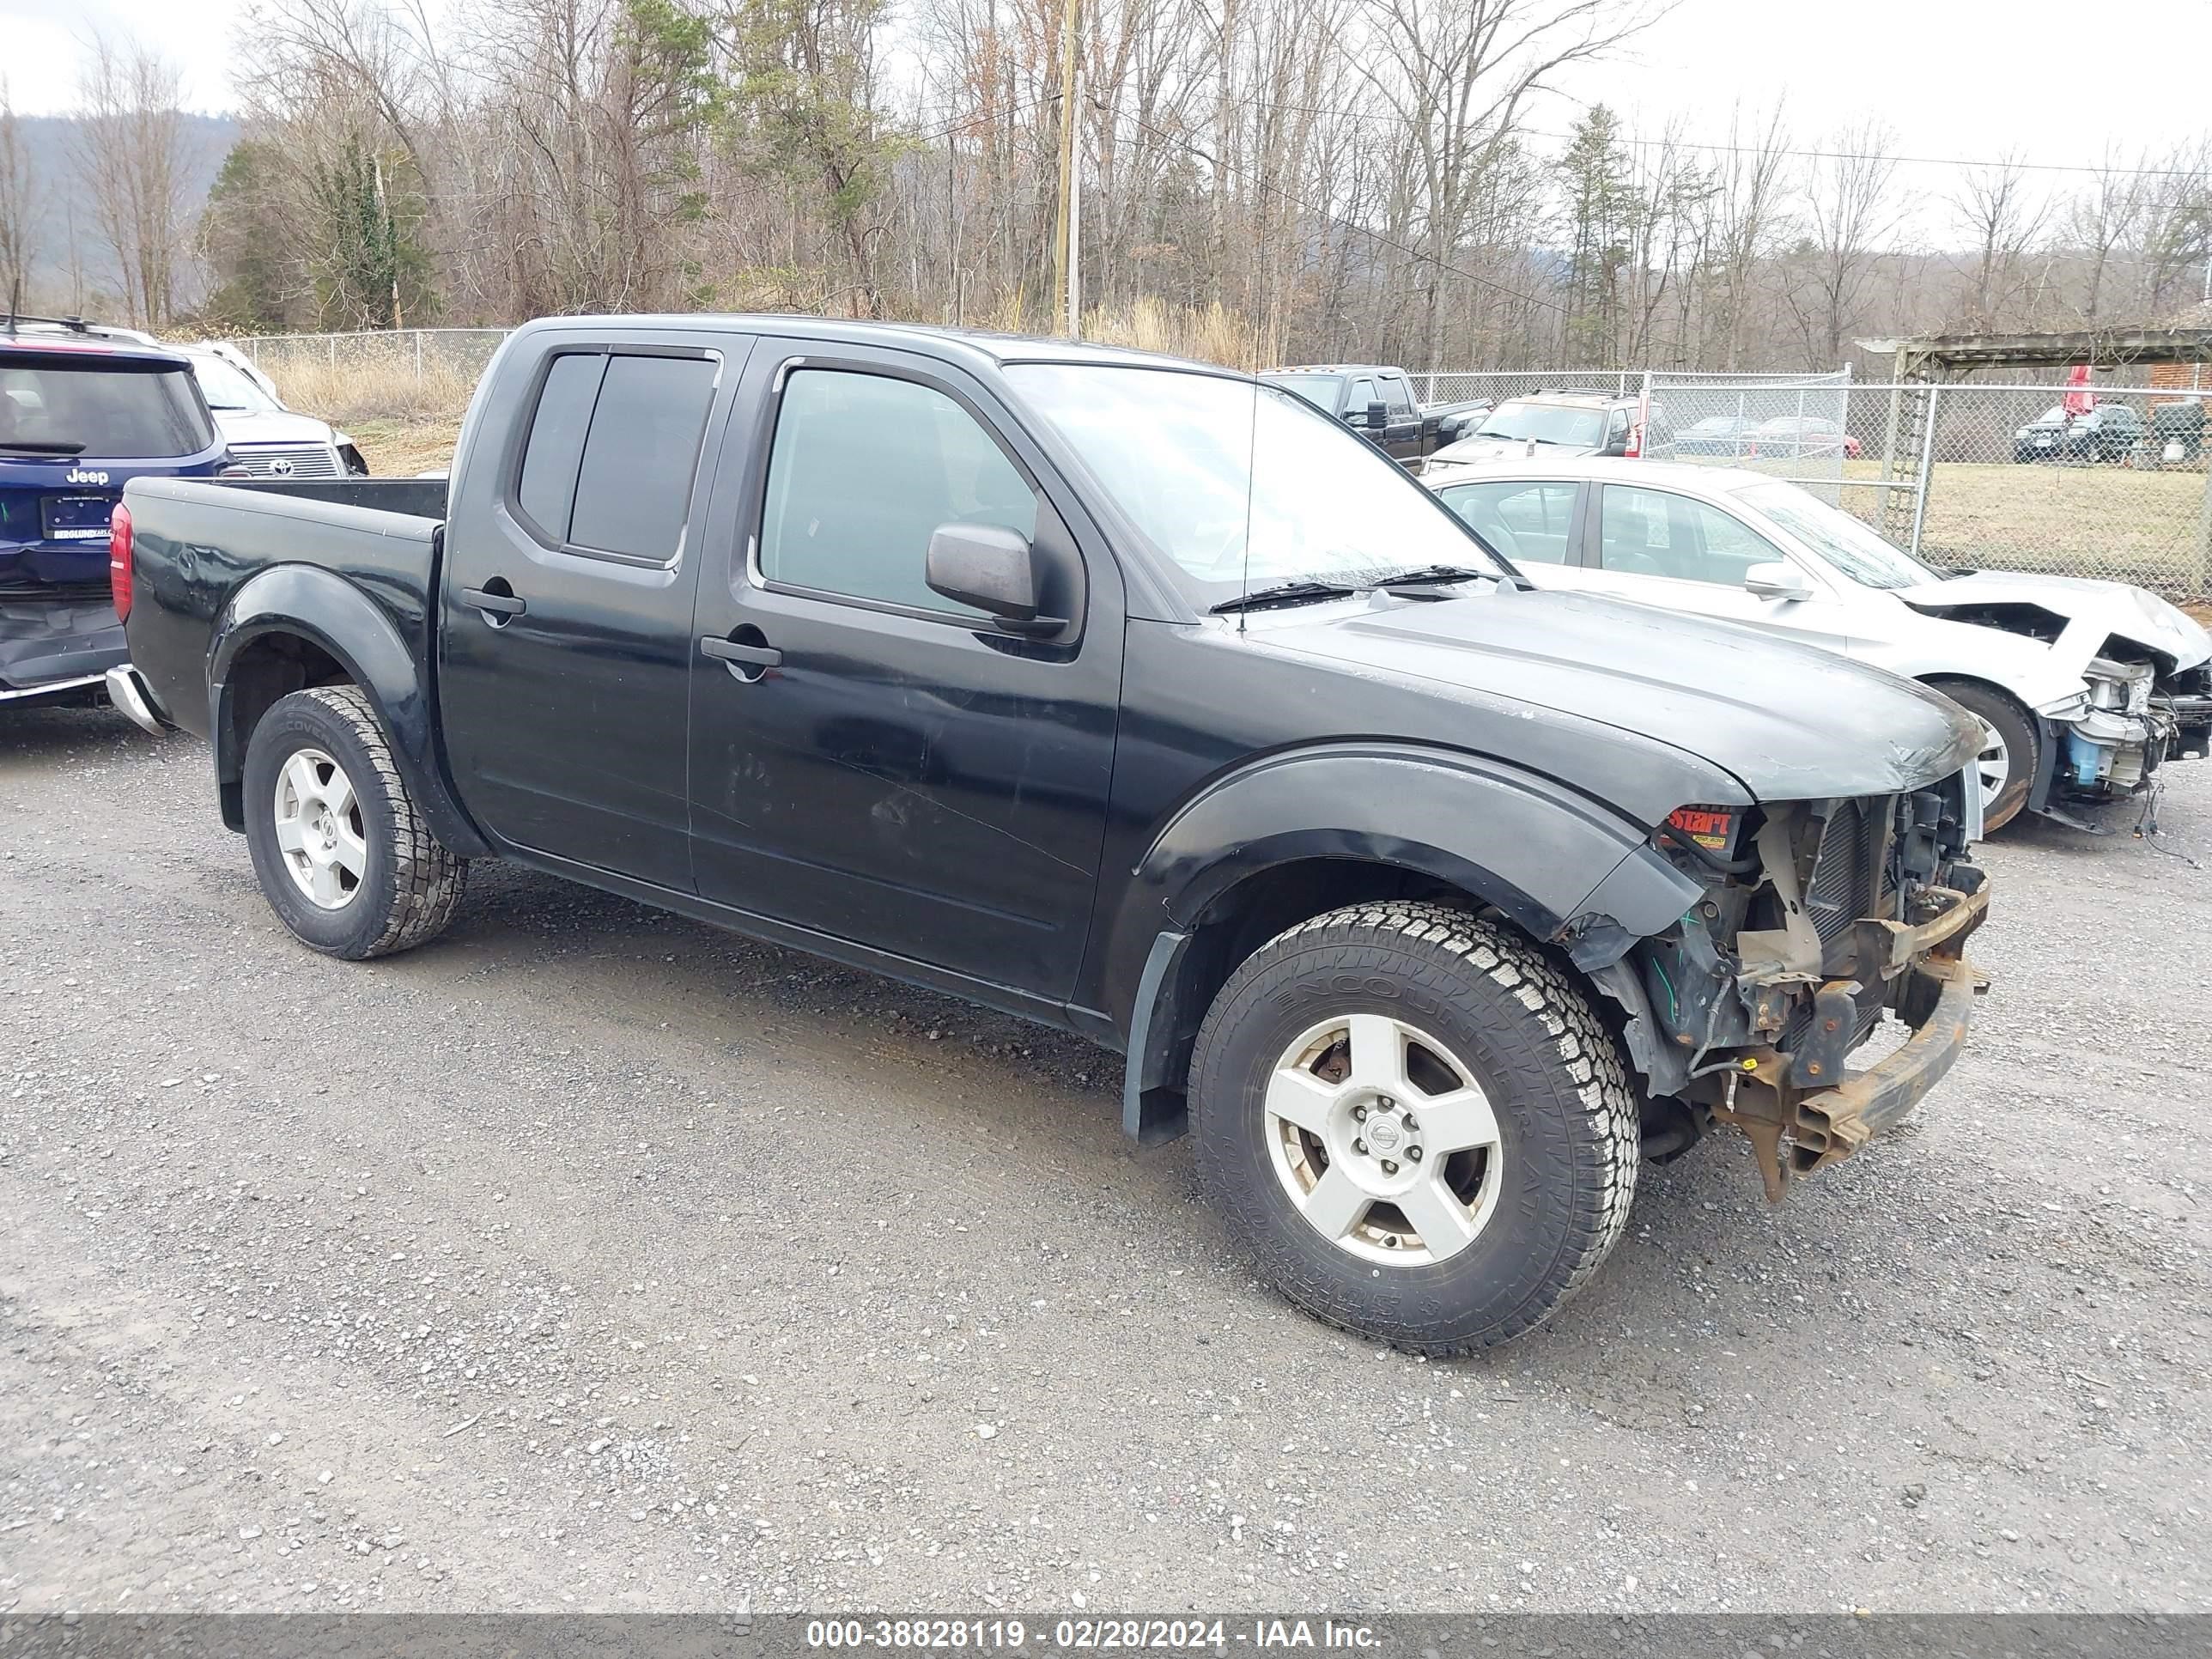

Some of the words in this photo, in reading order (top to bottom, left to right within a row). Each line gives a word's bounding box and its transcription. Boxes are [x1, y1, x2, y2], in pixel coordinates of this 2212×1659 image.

[65, 468, 109, 486] Jeep
[1270, 974, 1535, 1139] ENCOUNTER
[1522, 1157, 1541, 1224] AT
